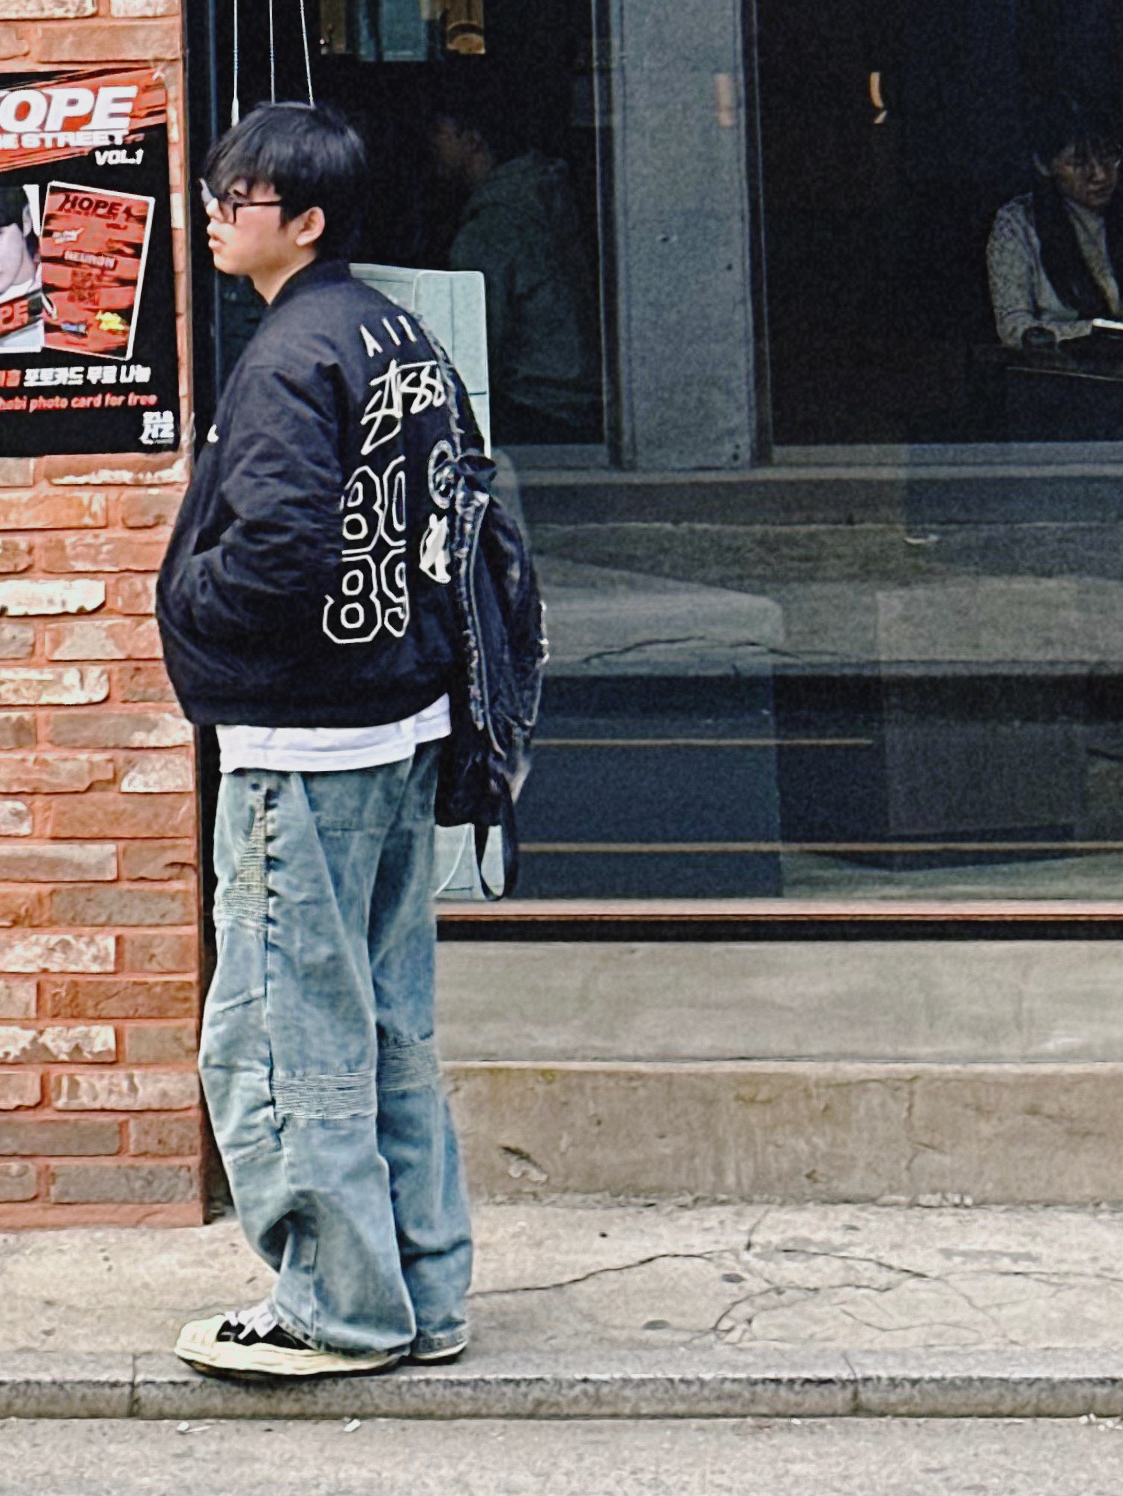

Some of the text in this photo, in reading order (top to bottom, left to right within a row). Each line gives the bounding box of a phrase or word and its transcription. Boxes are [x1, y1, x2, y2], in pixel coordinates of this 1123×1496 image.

[21, 129, 129, 149] STREET
[94, 148, 144, 166] VOL.1
[56, 193, 123, 217] HOPE
[29, 394, 69, 413] photo
[70, 392, 103, 409] card
[104, 391, 126, 407] for
[127, 391, 158, 407] free
